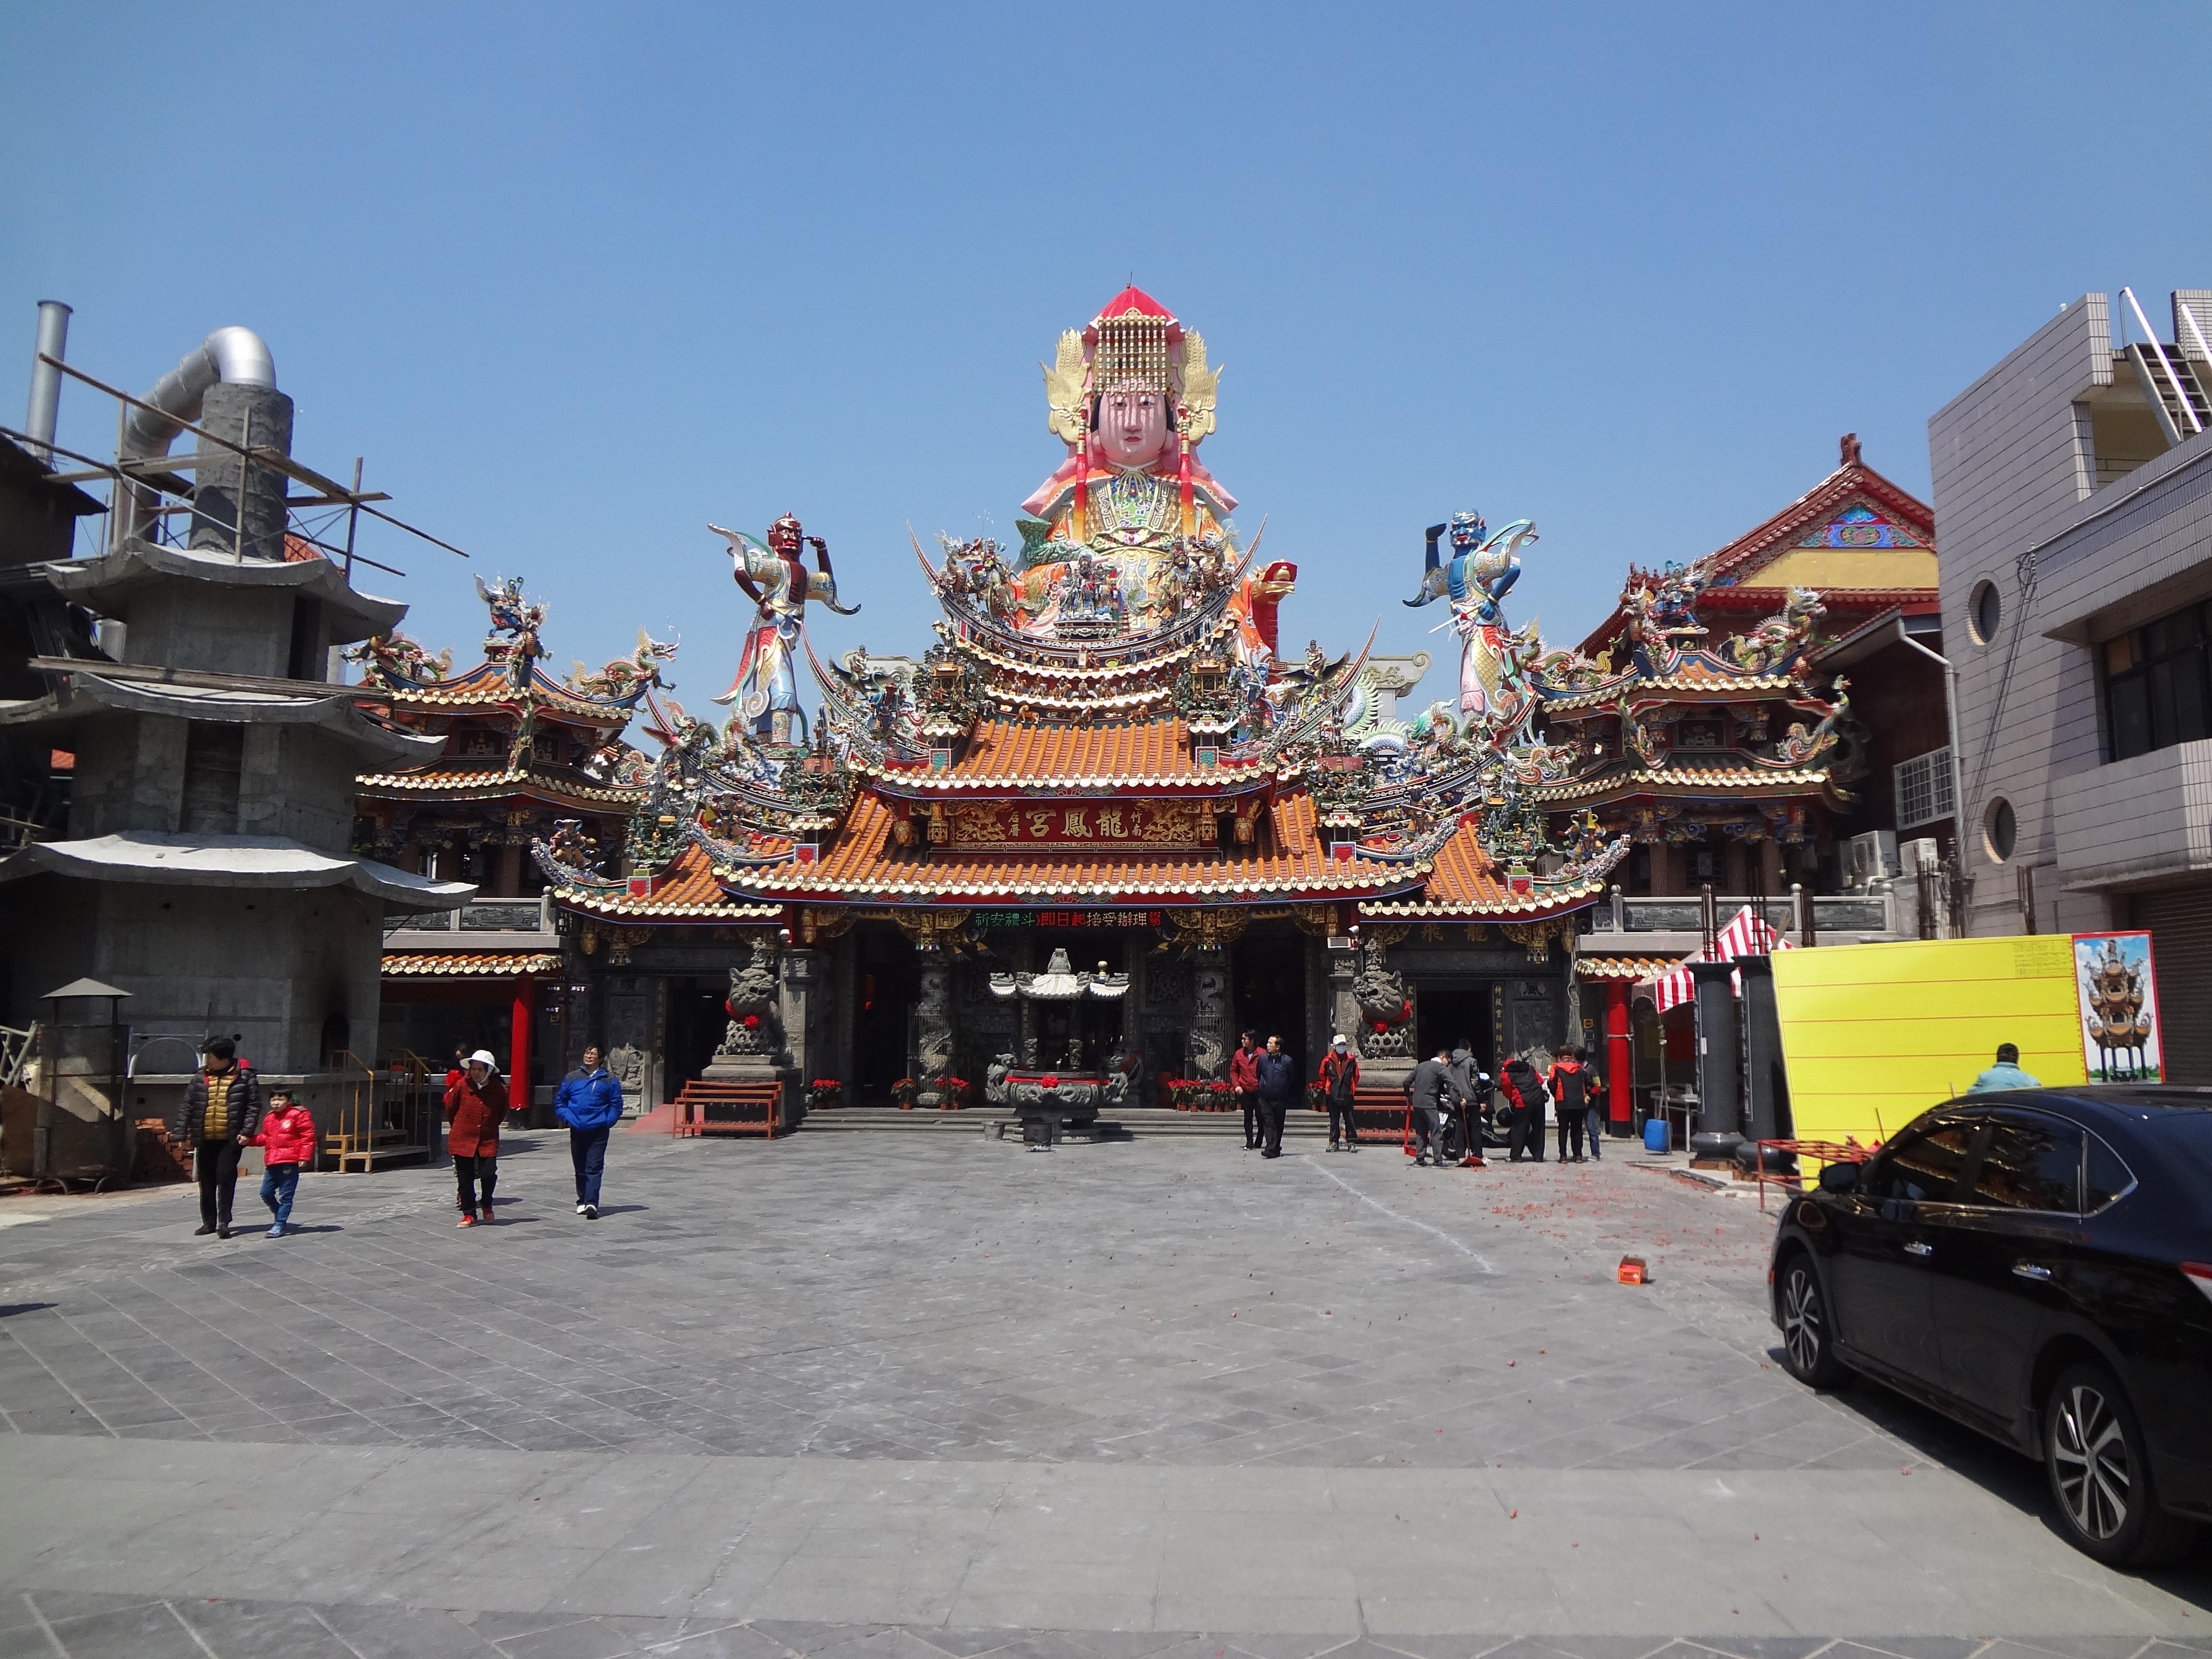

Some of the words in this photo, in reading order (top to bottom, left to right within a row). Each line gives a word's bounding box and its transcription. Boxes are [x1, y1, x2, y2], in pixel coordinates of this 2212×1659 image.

[1025, 803, 1129, 838] 龍鳳宮
[1130, 810, 1143, 837] 竹南
